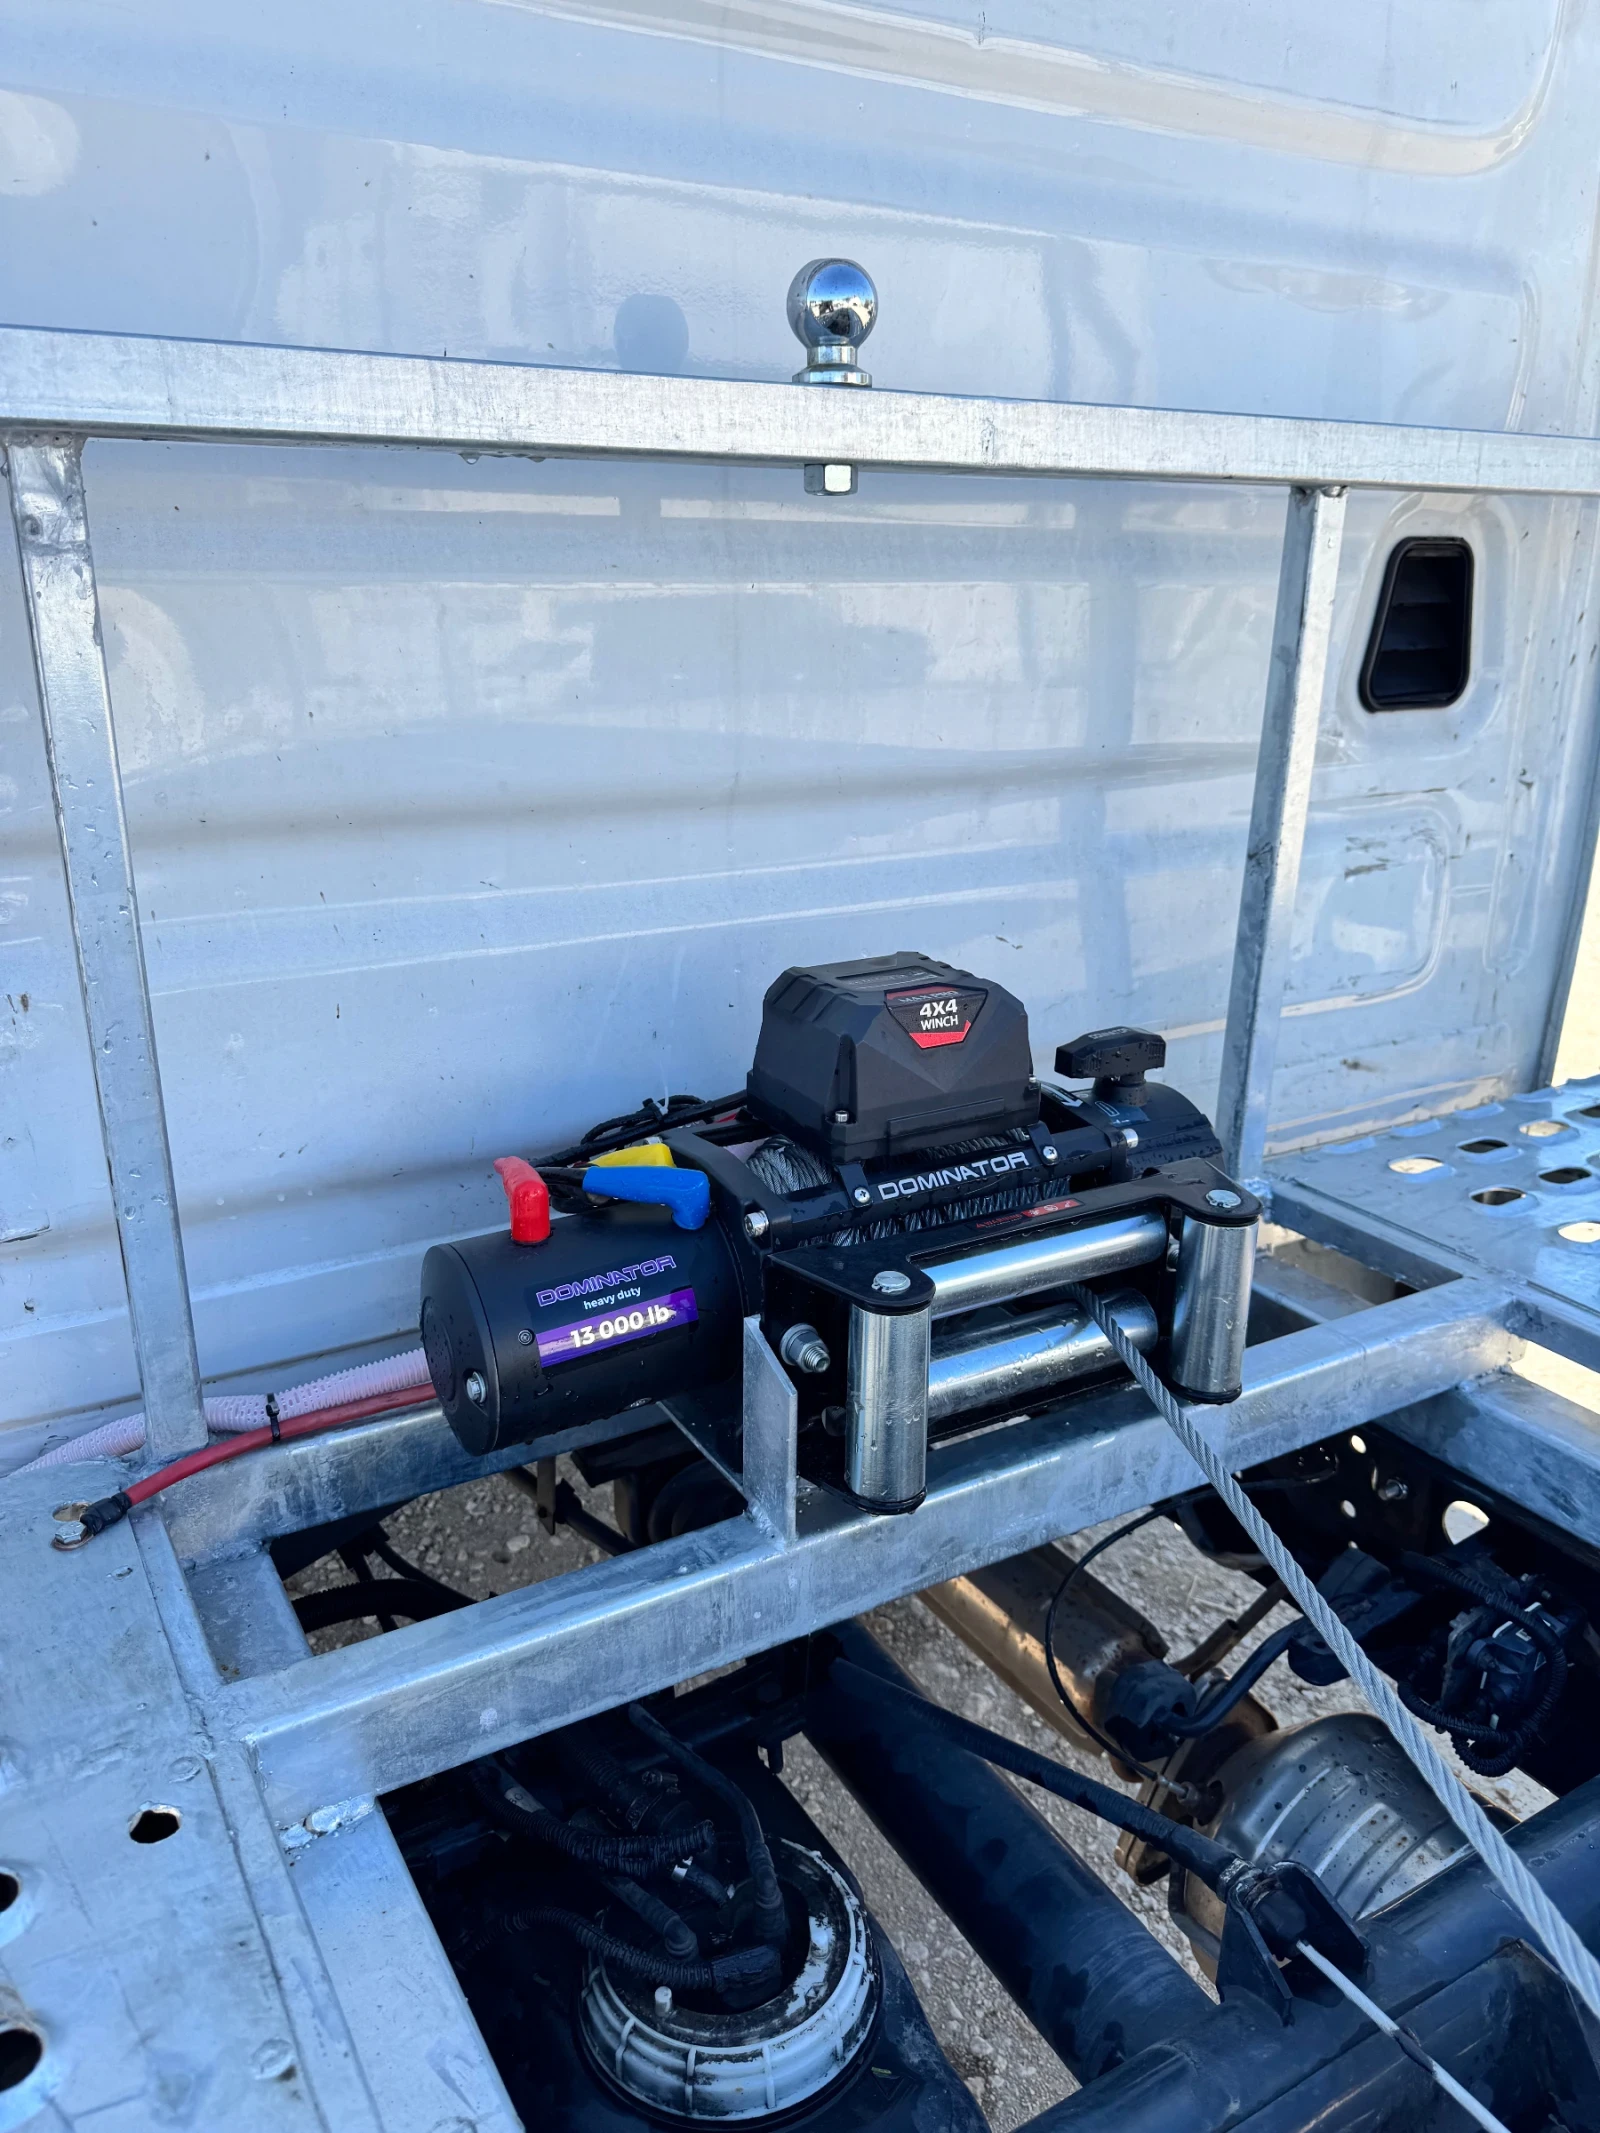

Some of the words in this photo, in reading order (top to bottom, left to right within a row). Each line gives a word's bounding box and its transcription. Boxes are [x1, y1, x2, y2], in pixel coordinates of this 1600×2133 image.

[919, 999, 958, 1018] 4X4
[920, 1014, 959, 1031] WINCH
[876, 1151, 1030, 1201] DOMINATOR
[535, 1255, 677, 1307] DOMINATOR
[583, 1293, 615, 1310] heavy
[617, 1286, 642, 1301] duty
[570, 1325, 596, 1348] 13
[599, 1311, 644, 1339] 000
[647, 1304, 671, 1325] lb
